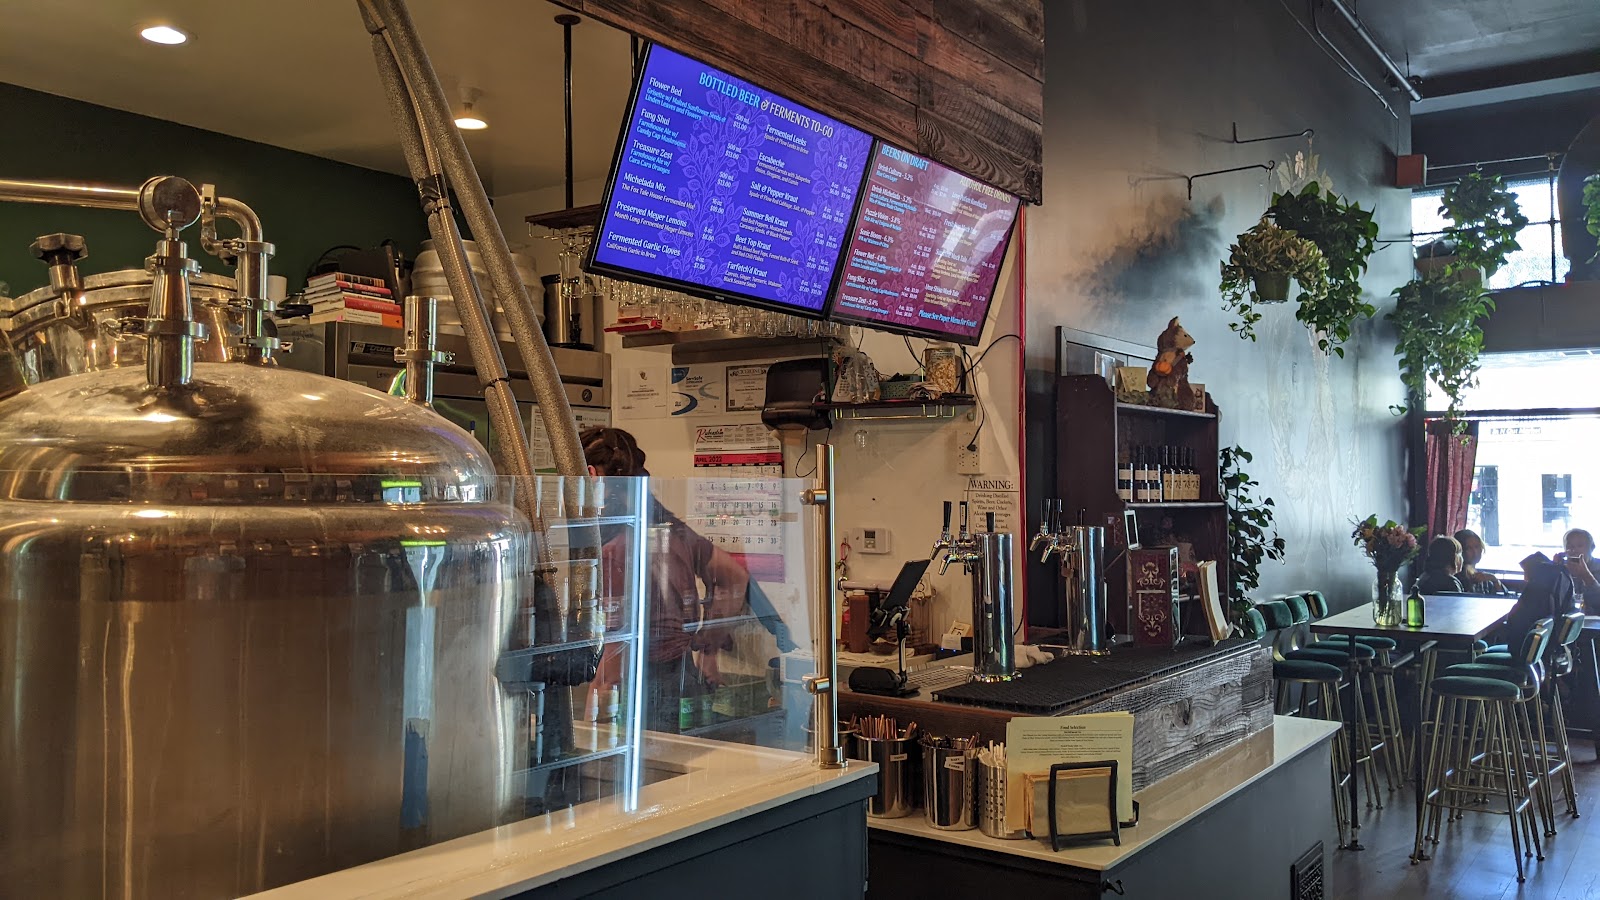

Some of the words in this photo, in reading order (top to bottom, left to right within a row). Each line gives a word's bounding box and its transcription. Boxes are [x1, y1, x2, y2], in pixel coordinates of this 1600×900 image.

[649, 77, 671, 92] Flower
[671, 86, 683, 97] Bed
[645, 94, 662, 106] Linden
[661, 101, 676, 111] Leaves
[676, 106, 685, 115] and
[685, 110, 702, 121] Flowers
[699, 73, 739, 99] BOTTLED
[738, 89, 761, 108] BEER
[770, 102, 811, 129] FERMENTS
[810, 119, 834, 138] TO-GO
[641, 108, 657, 121] Fung
[656, 114, 670, 126] Shui
[639, 119, 664, 133] Farmhouse
[664, 128, 673, 136] Ale
[766, 125, 793, 141] Fermented
[793, 135, 807, 147] Leeks
[637, 127, 652, 137] Candy
[652, 132, 661, 140] Cap
[661, 135, 687, 149] Mushrooms
[631, 149, 657, 162] Farmhouse
[656, 157, 665, 165] Ale
[633, 140, 661, 156] Treasure
[660, 149, 673, 160] Zest
[758, 152, 786, 168] Escabeche
[882, 144, 901, 160] BEERS
[901, 152, 911, 164] ON
[910, 156, 929, 171] DRAFT
[629, 156, 641, 166] Cara
[641, 160, 652, 169] Cara
[652, 164, 671, 175] Oranges
[624, 173, 655, 189] Michelada
[655, 182, 667, 192] Mix
[751, 181, 762, 192] Salt
[767, 187, 786, 199] Pepper
[785, 193, 799, 204] Kraut
[960, 176, 983, 192] ALCOHOL
[982, 185, 995, 197] FREE
[994, 191, 1012, 204] DRINKS
[622, 183, 631, 191] The
[630, 186, 639, 194] Fox
[639, 188, 649, 196] Tale
[649, 191, 664, 201] House
[663, 196, 686, 207] Fermented
[614, 211, 629, 221] Month
[629, 215, 641, 224] Long
[641, 218, 664, 230] Fermented
[664, 225, 678, 234] Meyer
[678, 228, 694, 238] Lemons
[616, 201, 647, 217] Preserved
[647, 210, 666, 222] Meyer
[665, 215, 688, 228] Lemons
[743, 208, 765, 220] Summer
[765, 214, 775, 223] Bell
[774, 217, 789, 227] Kraut
[606, 242, 628, 252] California
[608, 232, 643, 247] Fermented
[643, 240, 662, 251] Garlic
[661, 245, 681, 256] Cloves
[735, 235, 747, 244] Beet
[747, 238, 758, 247] Top
[757, 241, 772, 251] Kraut
[753, 268, 768, 277] Kraut
[919, 310, 932, 319] Please
[931, 312, 940, 320] See
[939, 314, 951, 322] Paper
[950, 316, 961, 324] Menu
[969, 480, 1014, 490] WARNING:
